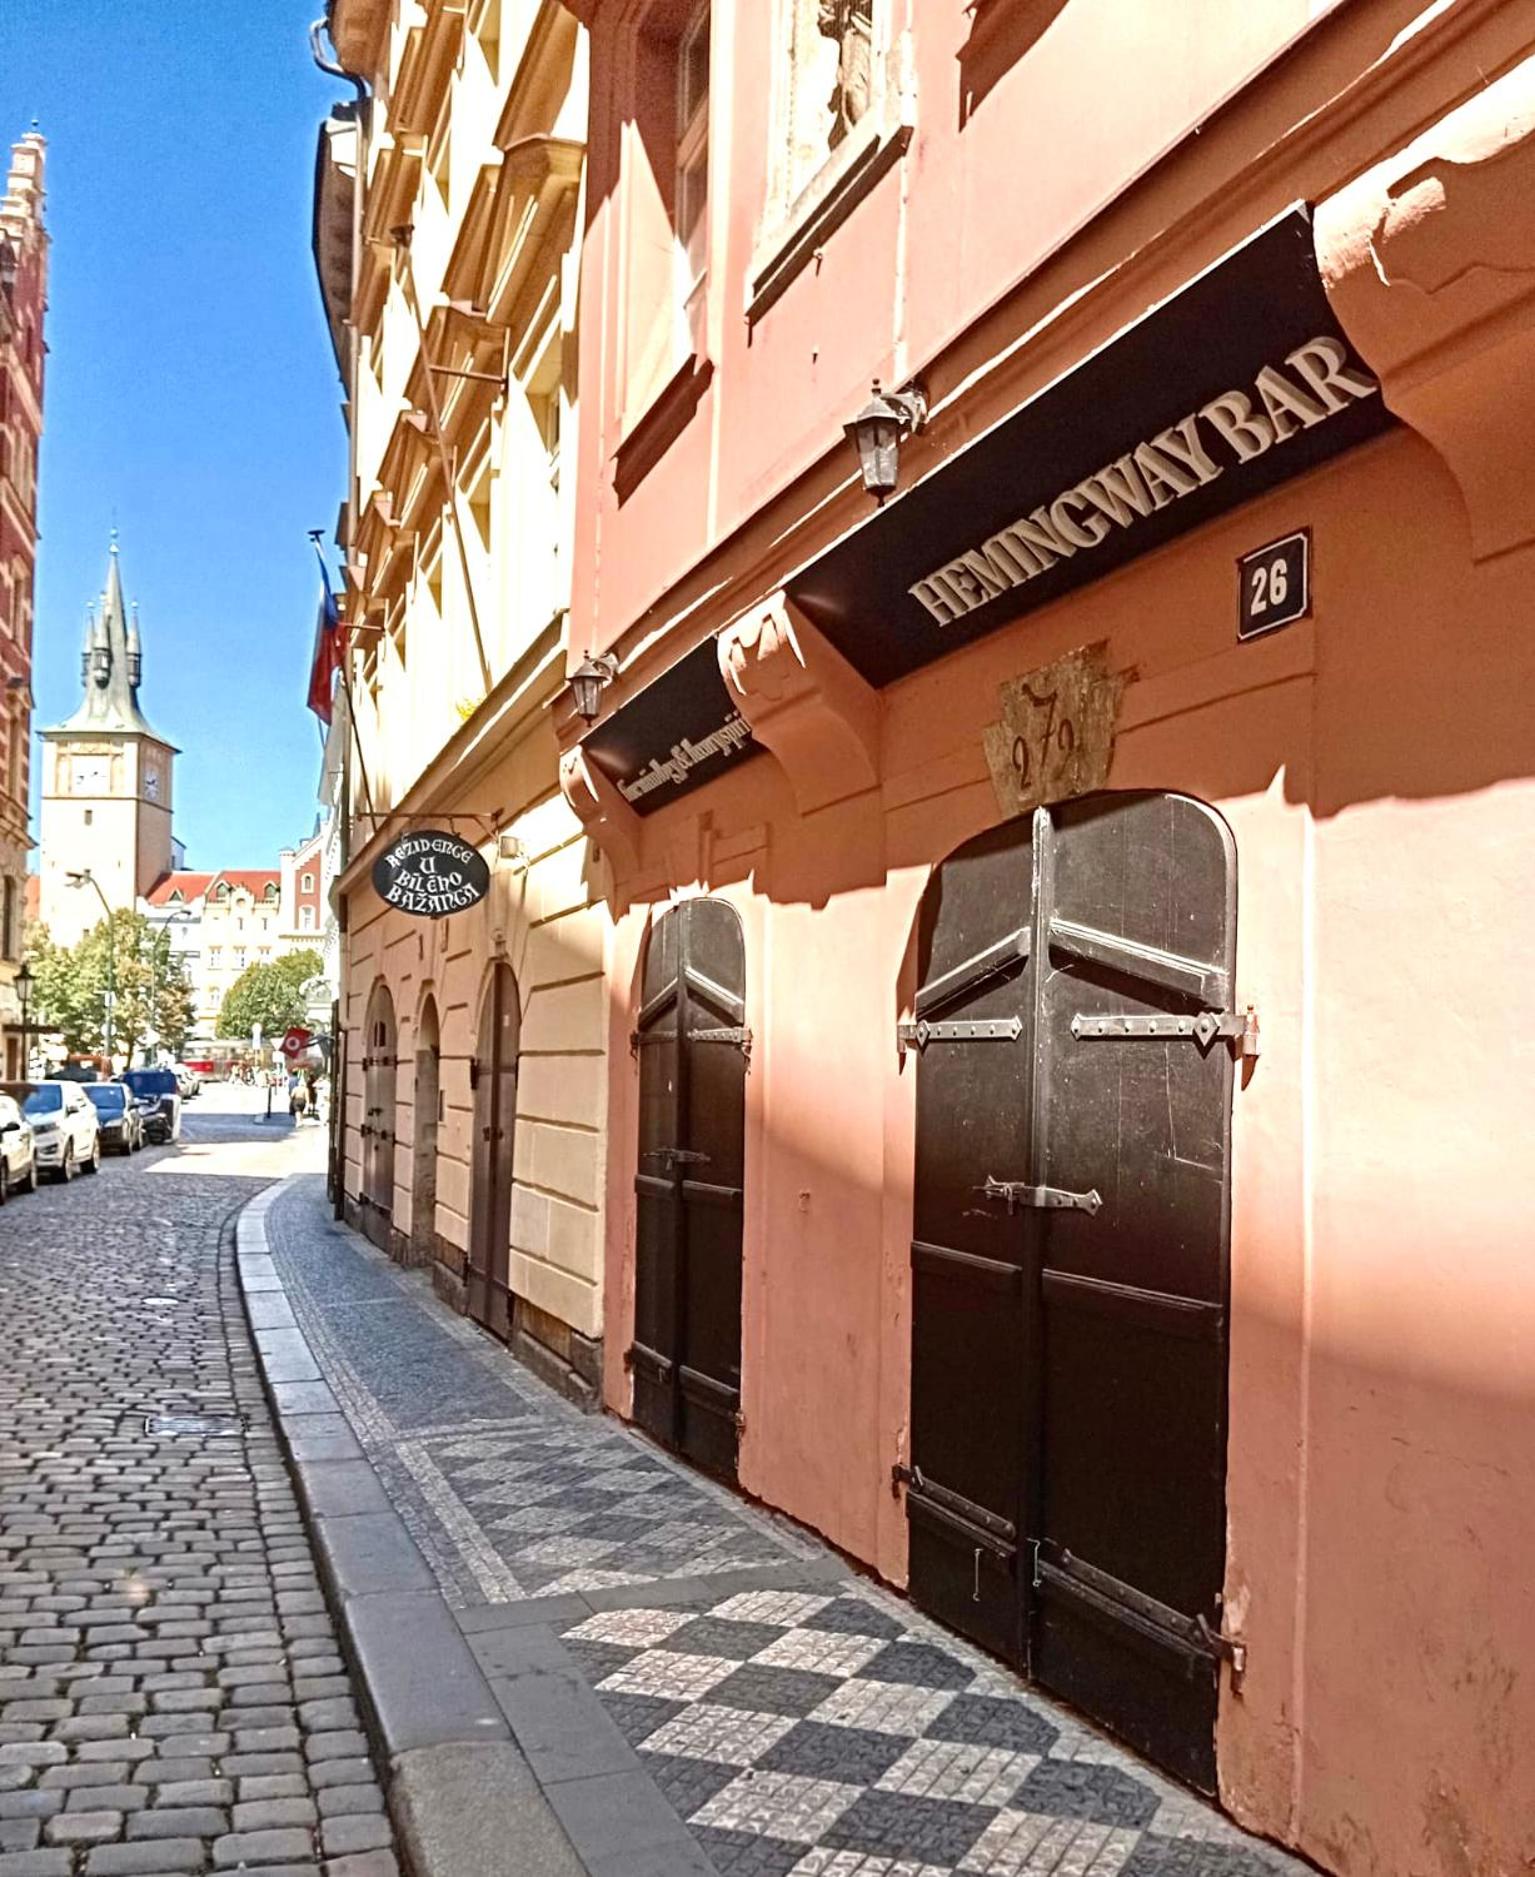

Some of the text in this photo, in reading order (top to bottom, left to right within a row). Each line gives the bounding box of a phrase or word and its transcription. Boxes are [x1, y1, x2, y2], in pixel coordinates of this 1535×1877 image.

[907, 335, 1379, 628] HEMINGWAY BAR
[1250, 558, 1287, 616] 26
[385, 839, 474, 868] REZIDENCE
[420, 856, 437, 874] U
[385, 882, 480, 912] BAŽANTA
